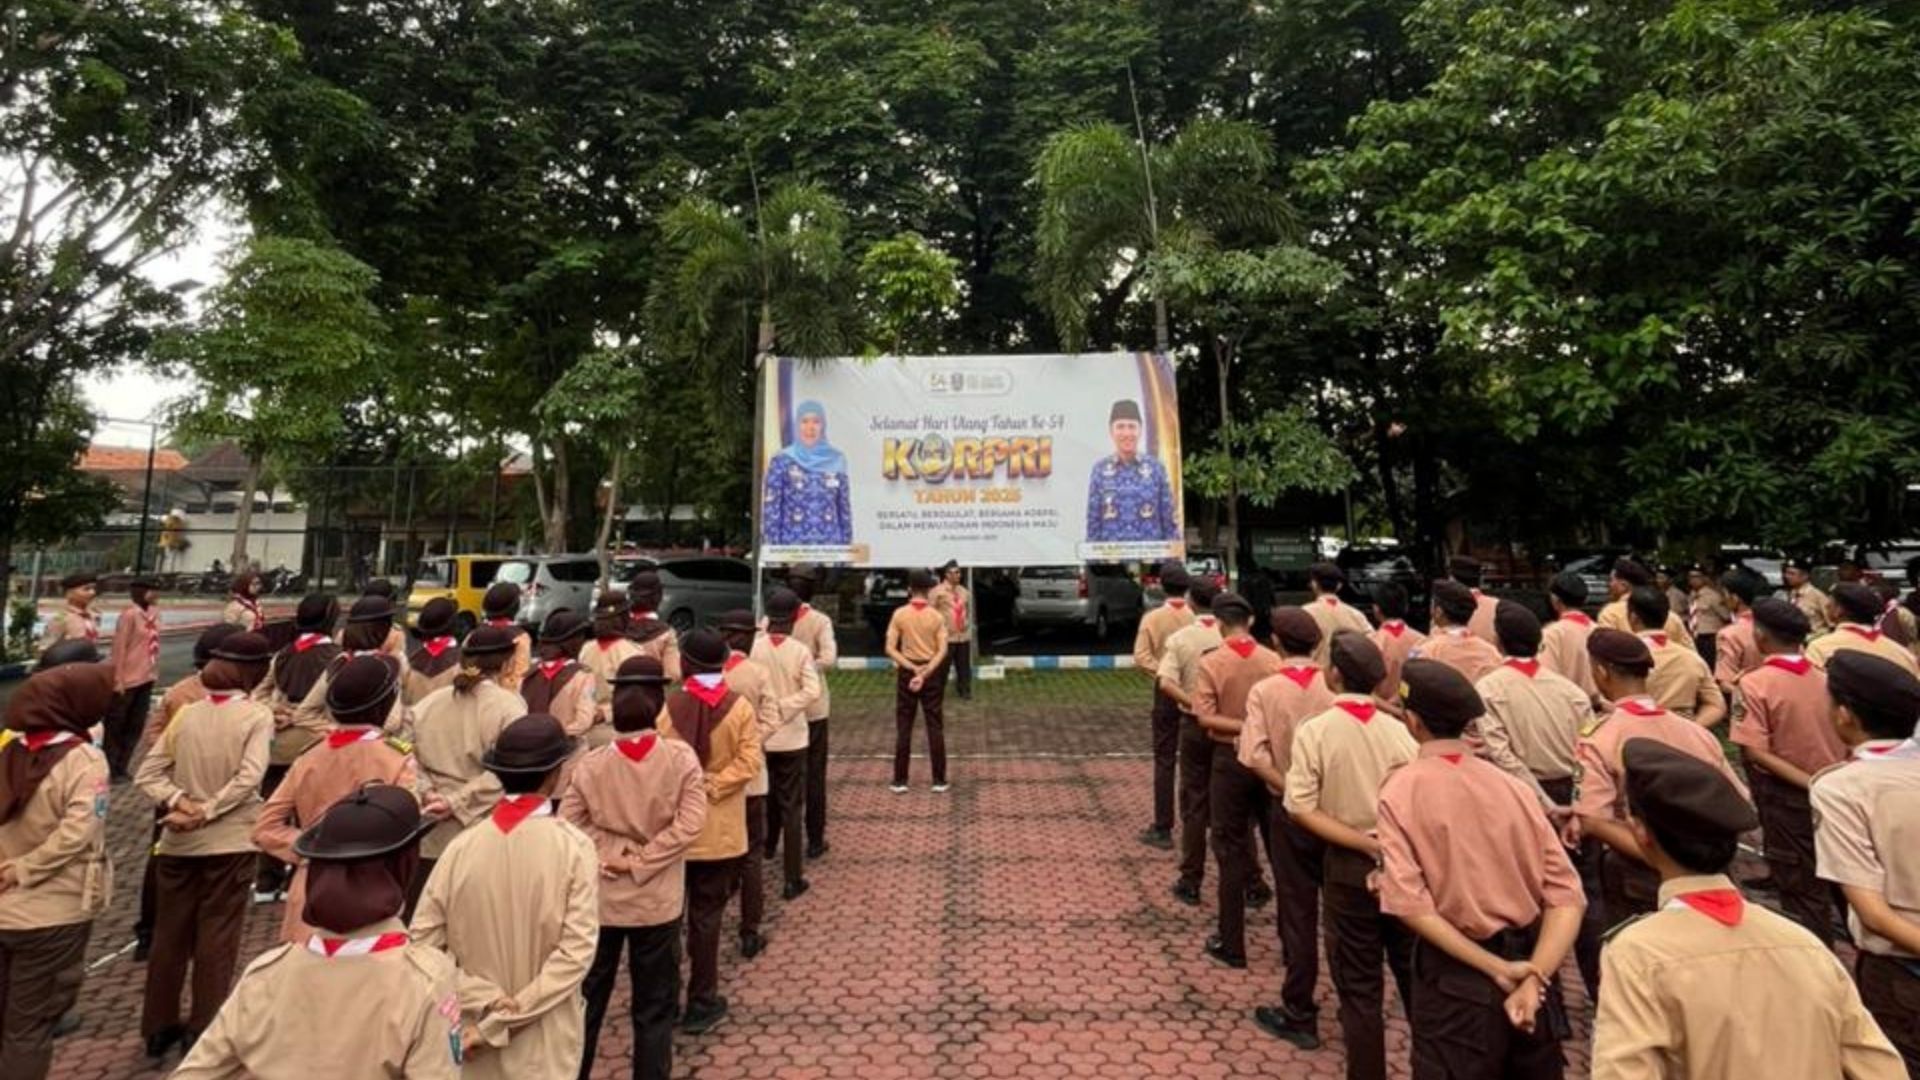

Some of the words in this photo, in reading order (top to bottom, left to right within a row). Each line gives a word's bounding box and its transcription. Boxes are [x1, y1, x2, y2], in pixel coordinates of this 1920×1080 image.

[869, 414, 919, 431] Selamat
[922, 413, 949, 430] Hari
[953, 413, 987, 434] Ulang
[990, 413, 1027, 430] Tahun
[882, 432, 1053, 484] KORPRI
[914, 489, 976, 504] TAHUN
[981, 519, 1030, 529] INDONESIA
